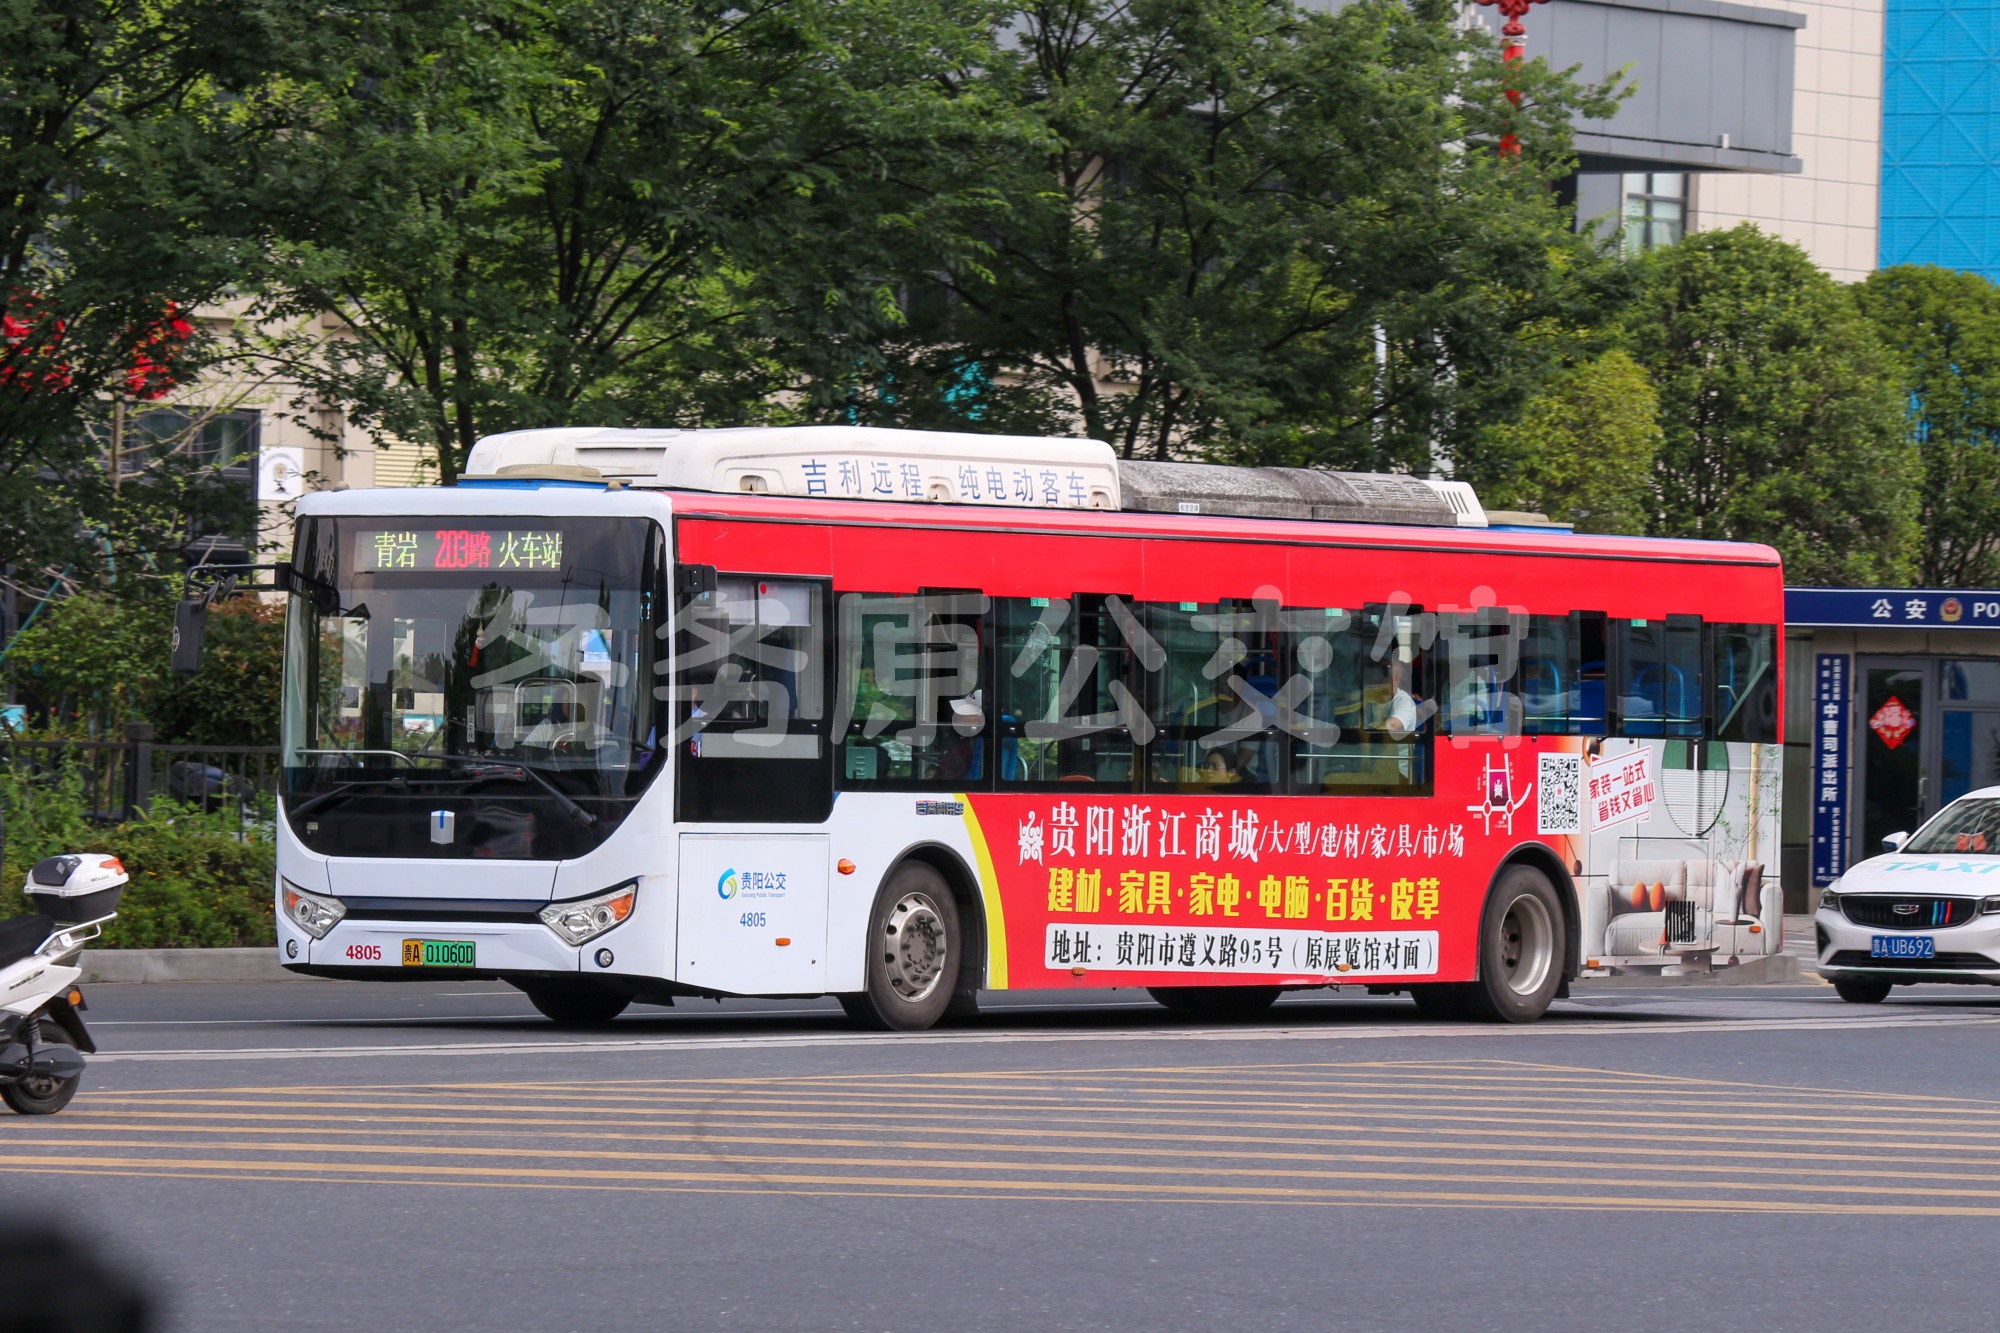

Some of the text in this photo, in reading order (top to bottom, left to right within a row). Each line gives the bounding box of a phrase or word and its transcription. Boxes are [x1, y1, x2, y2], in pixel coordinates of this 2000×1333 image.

[801, 459, 1088, 505] 吉利远程 纯电动客车
[374, 530, 563, 569] 青岩 203路 火车站
[1870, 598, 1928, 619] 公安
[1820, 702, 1840, 802] 中曹司派出所
[1588, 759, 1646, 799] 家装一站式
[1598, 781, 1655, 822] 省钱又省心
[1048, 801, 1259, 863] 贵阳浙江商城
[741, 872, 786, 890] 贵阳公交
[740, 912, 766, 927] 4805
[345, 944, 382, 960] 4805
